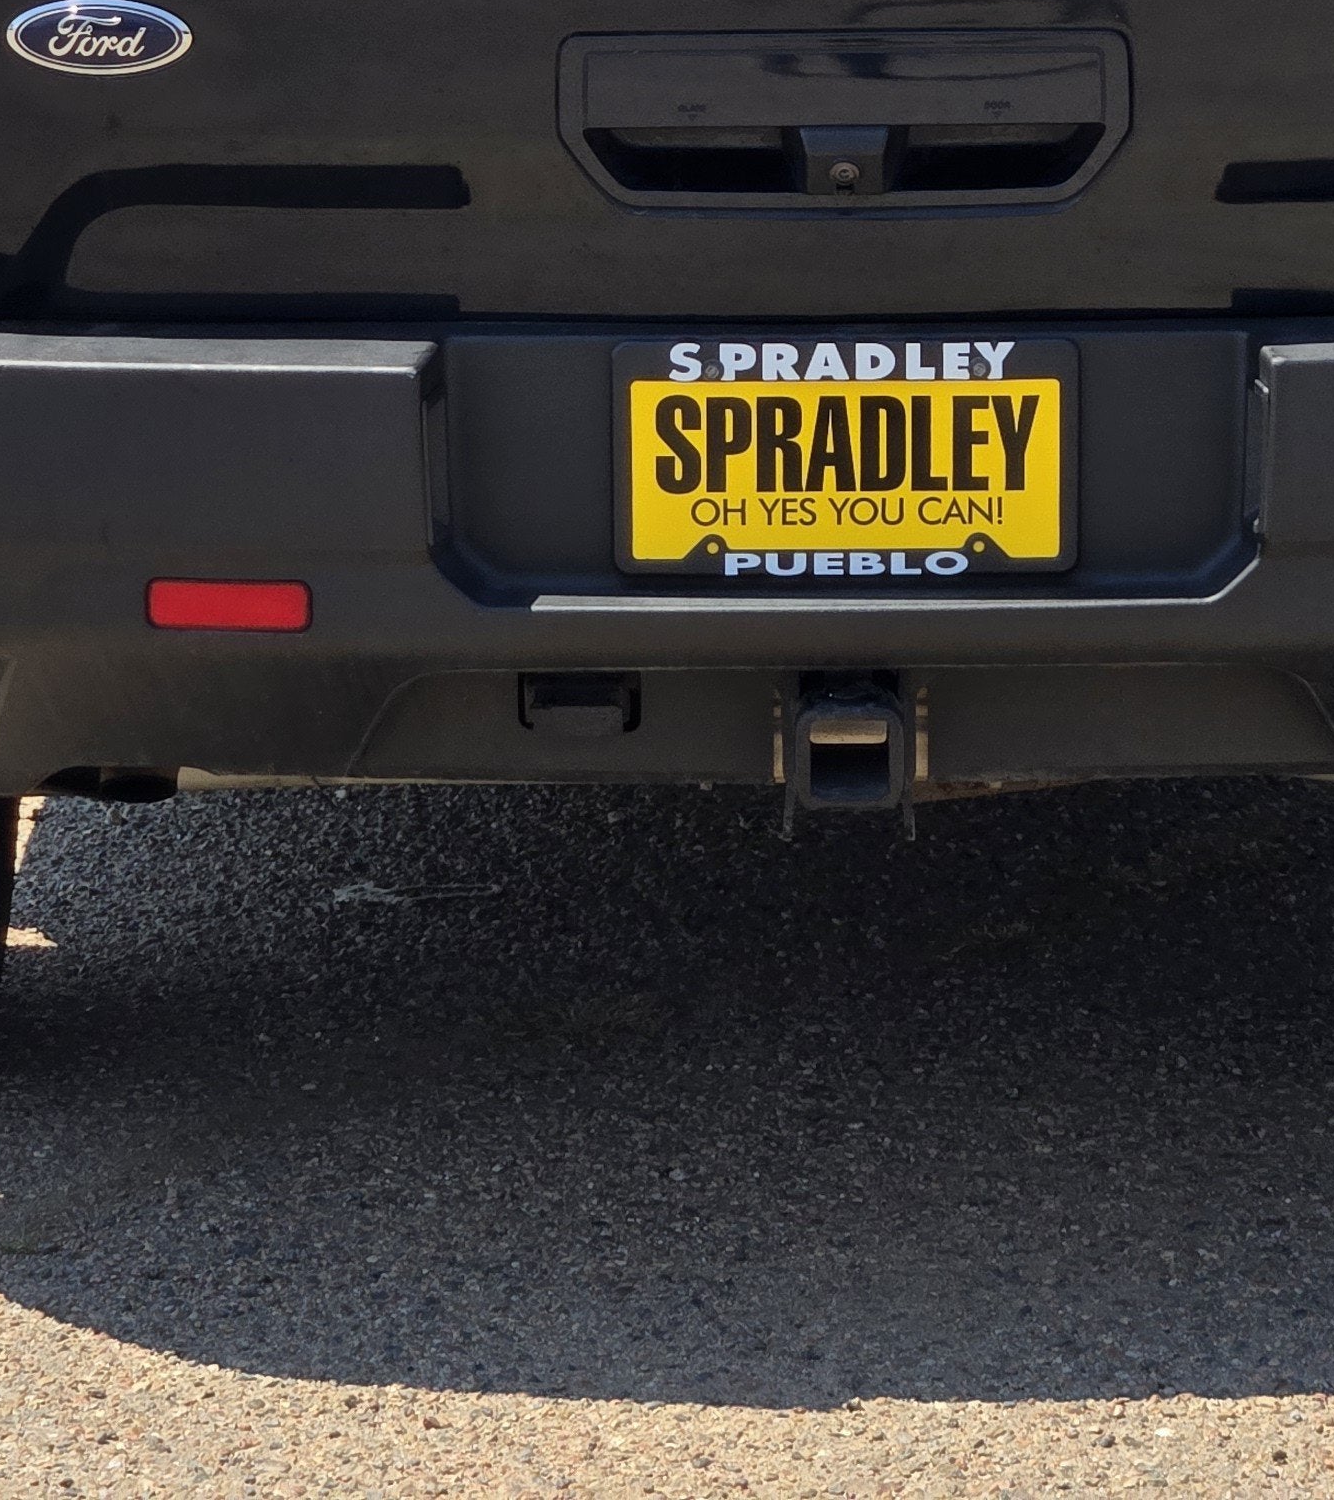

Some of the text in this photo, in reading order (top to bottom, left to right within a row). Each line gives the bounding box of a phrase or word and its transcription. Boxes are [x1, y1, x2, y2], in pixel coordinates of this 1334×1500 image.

[48, 14, 147, 57] Ford
[668, 341, 1015, 381] SPRADLEY
[655, 393, 1040, 495] SPRADLEY
[691, 496, 1004, 526] OH YES YOU CAN!
[724, 552, 968, 577] PUEBLO
